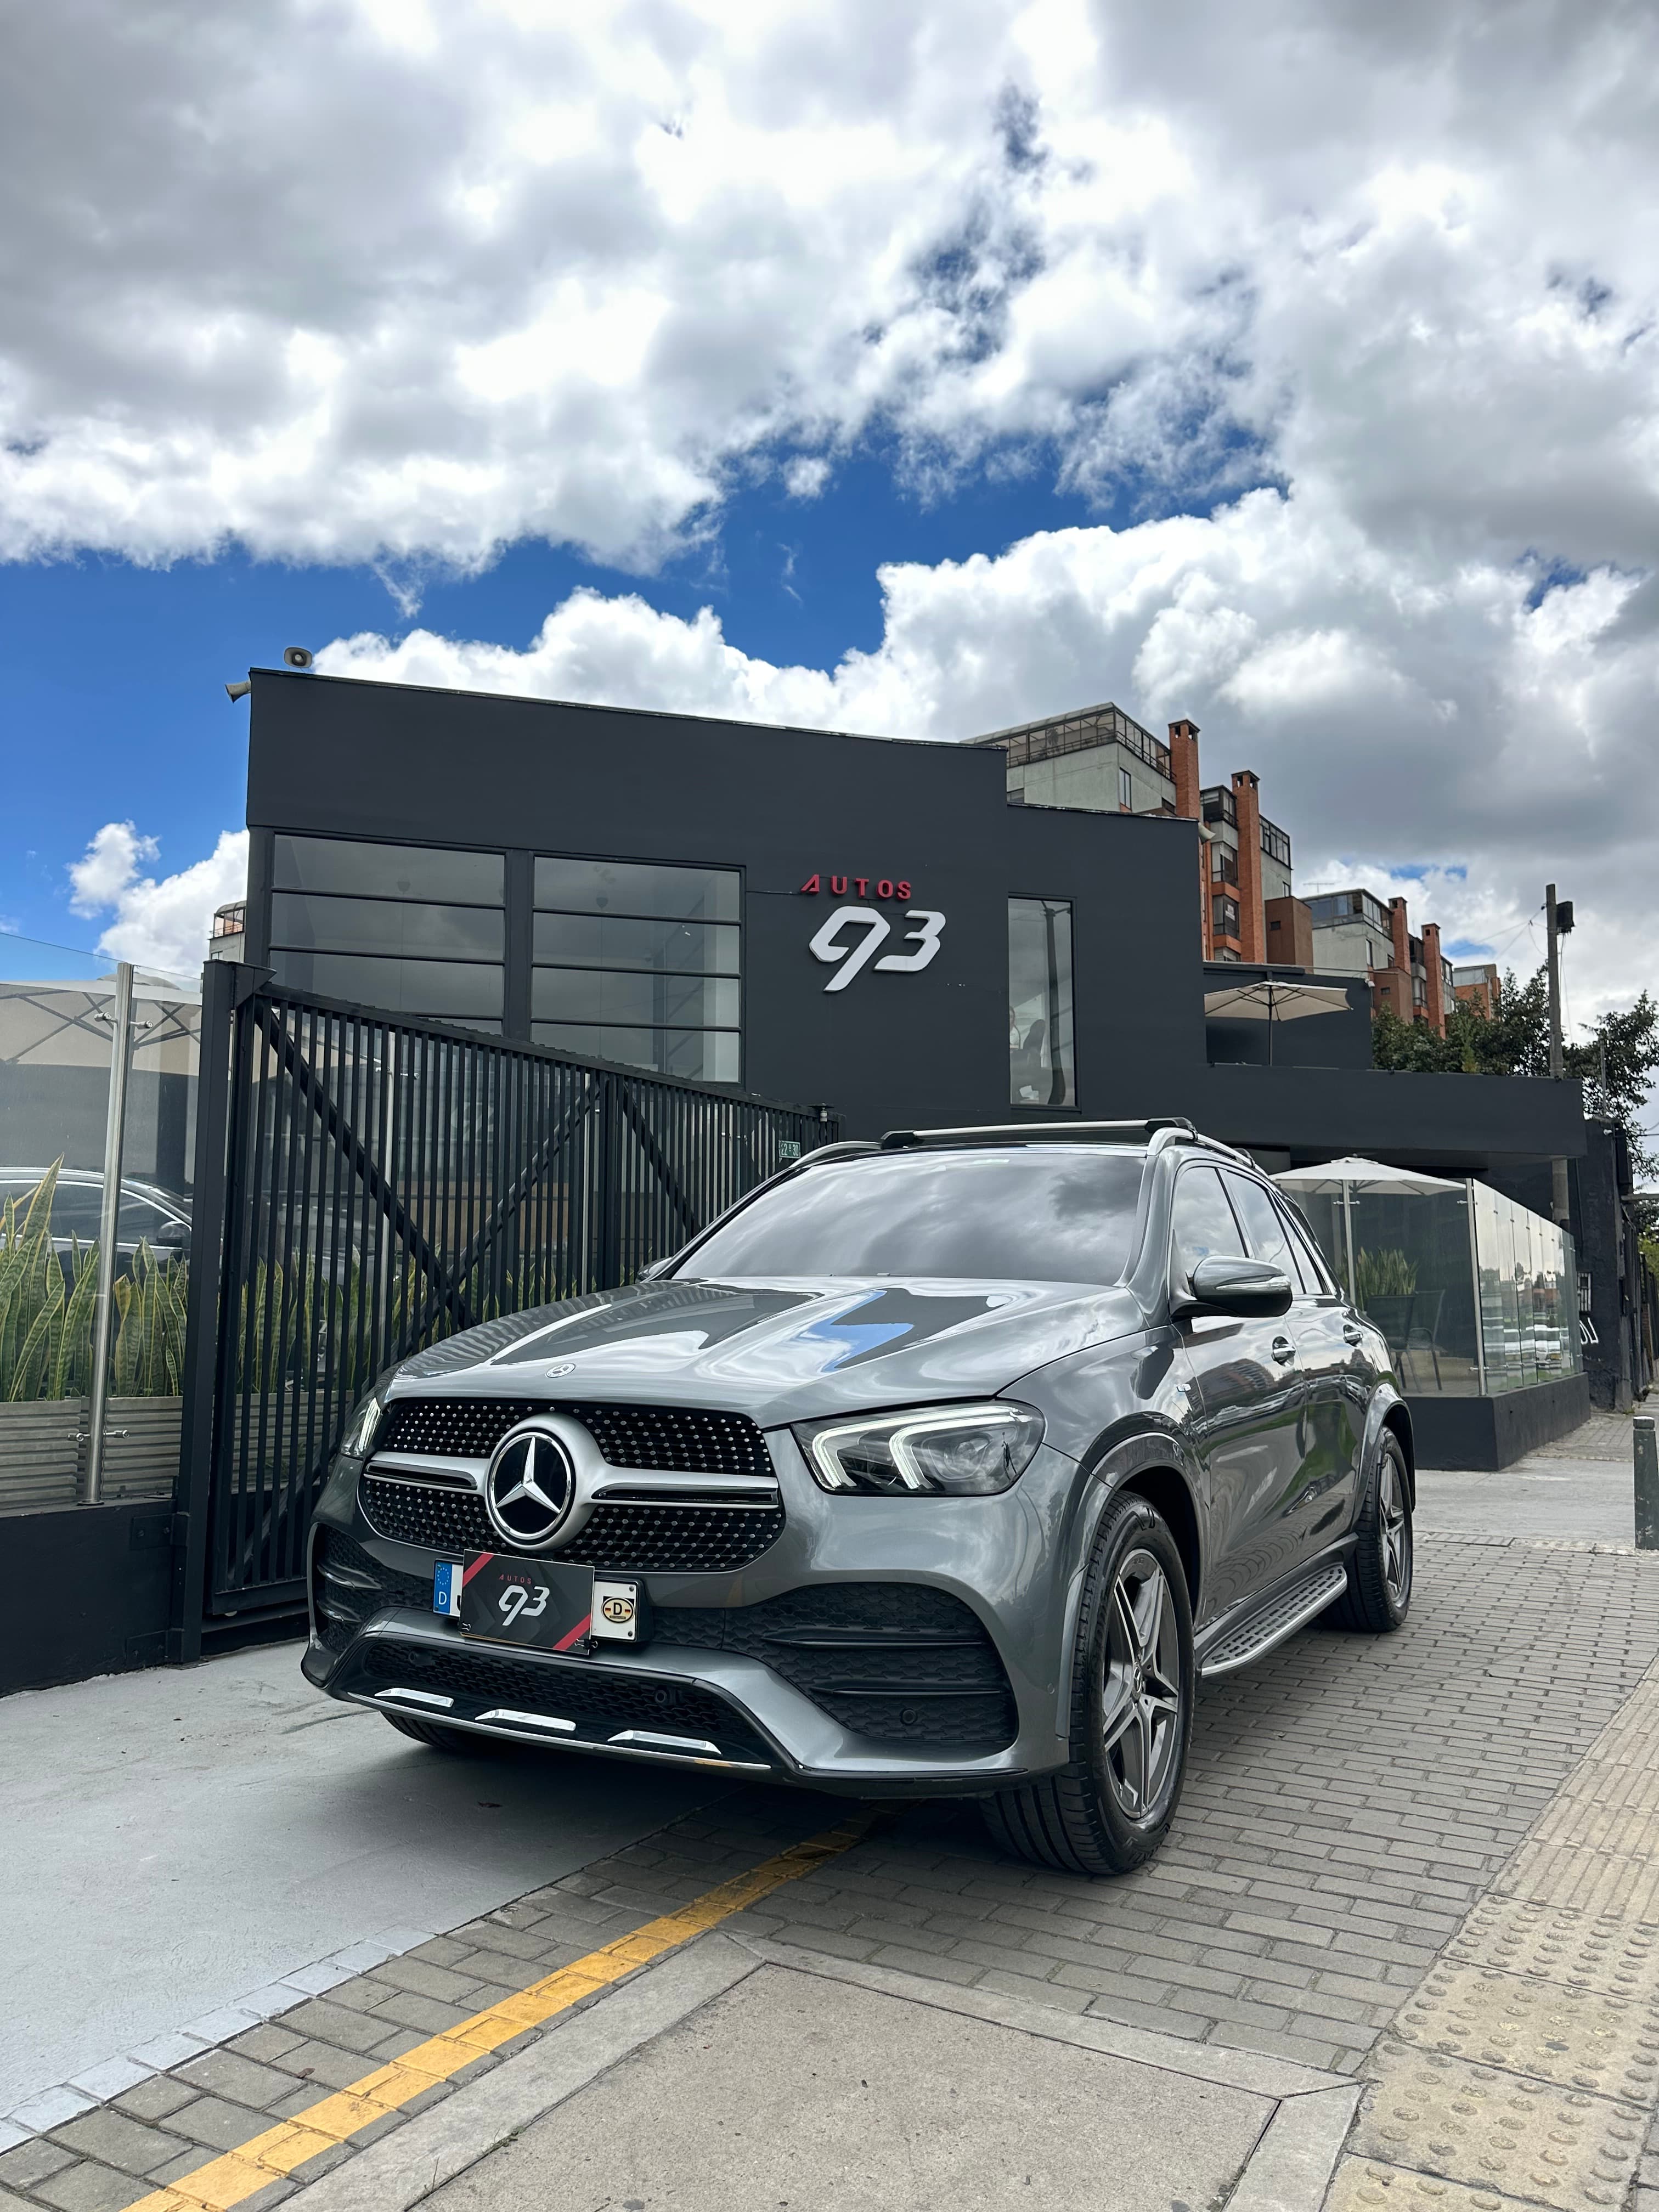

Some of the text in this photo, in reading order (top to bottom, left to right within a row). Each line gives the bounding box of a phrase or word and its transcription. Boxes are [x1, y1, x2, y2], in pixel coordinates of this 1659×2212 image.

[800, 874, 911, 900] AUTOS
[809, 906, 946, 992] 93
[499, 1574, 532, 1584] AUTOS
[438, 1591, 447, 1605] D
[498, 1585, 550, 1626] 93
[613, 1602, 622, 1615] D
